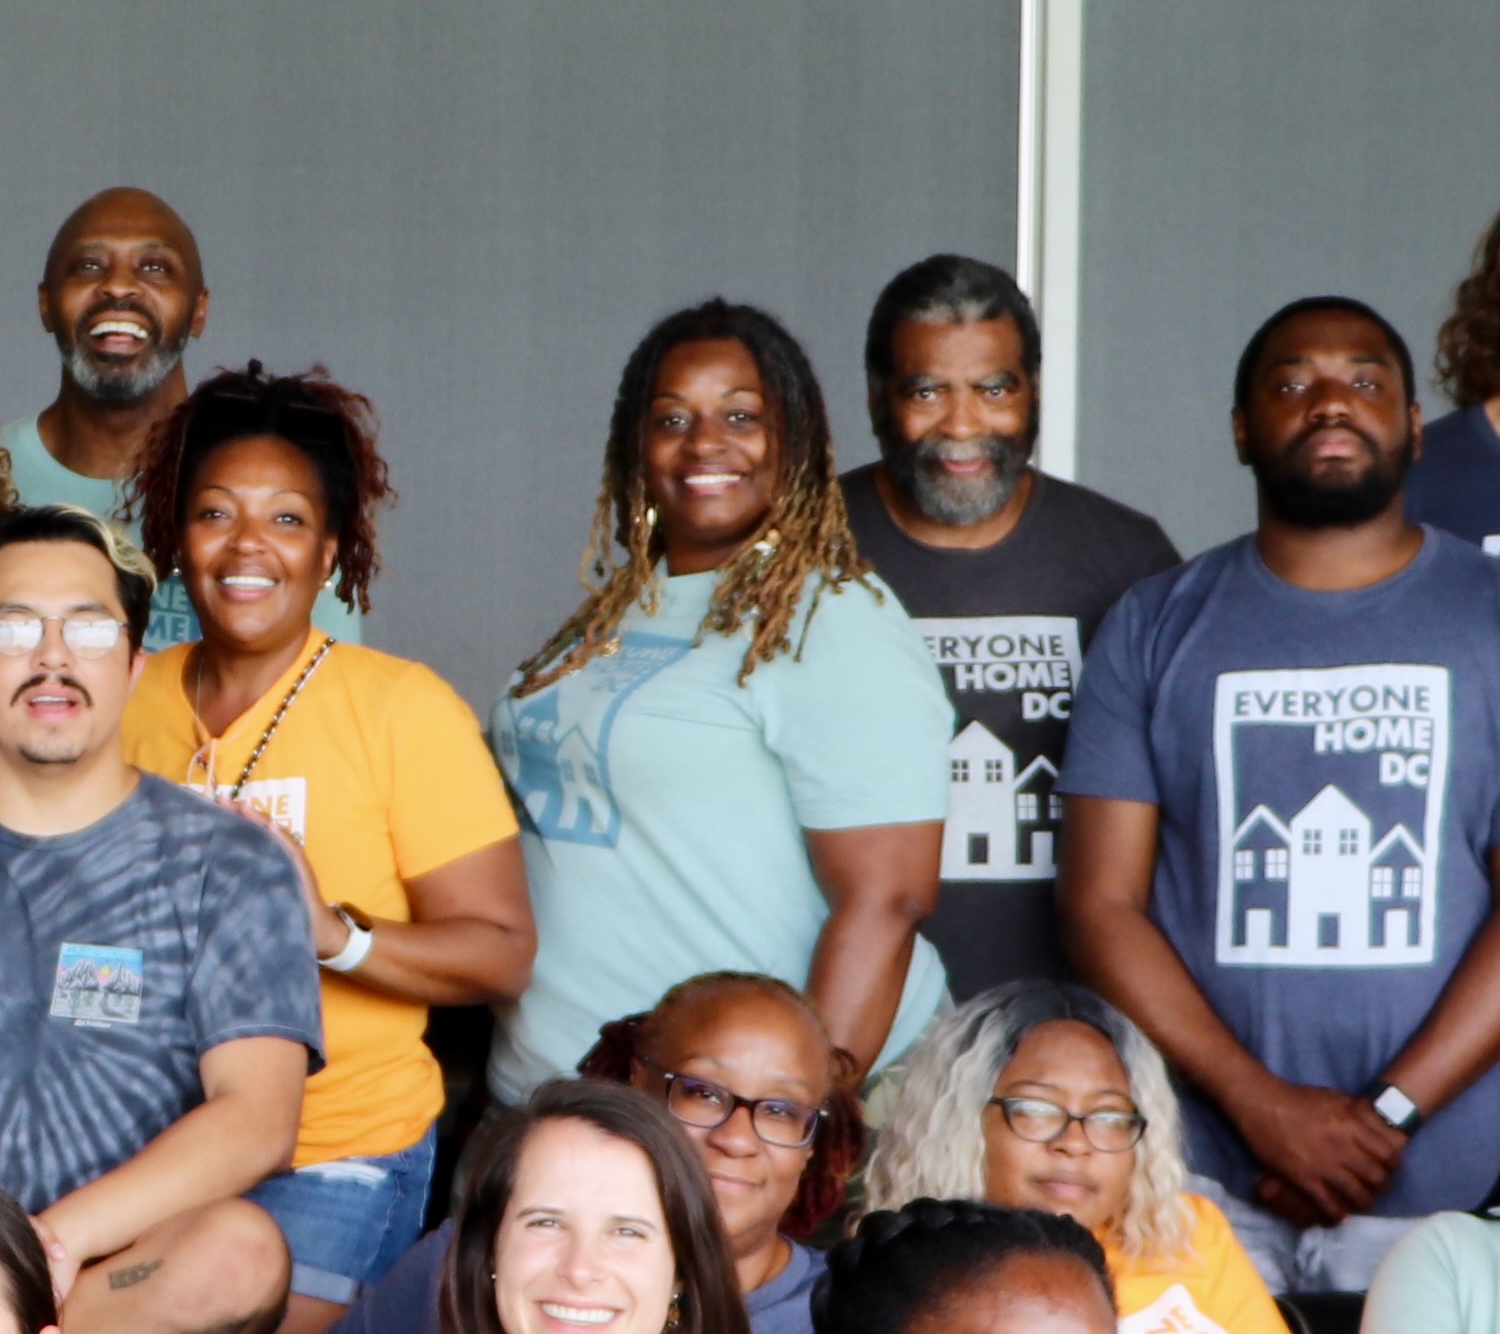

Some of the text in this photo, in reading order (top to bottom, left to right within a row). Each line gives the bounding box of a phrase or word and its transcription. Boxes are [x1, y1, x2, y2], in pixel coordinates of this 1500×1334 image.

[955, 662, 1070, 691] HOME
[1022, 691, 1072, 720] DC
[1233, 685, 1431, 718] EVERYONE
[1314, 718, 1432, 754] HOME
[1379, 753, 1430, 786] DC
